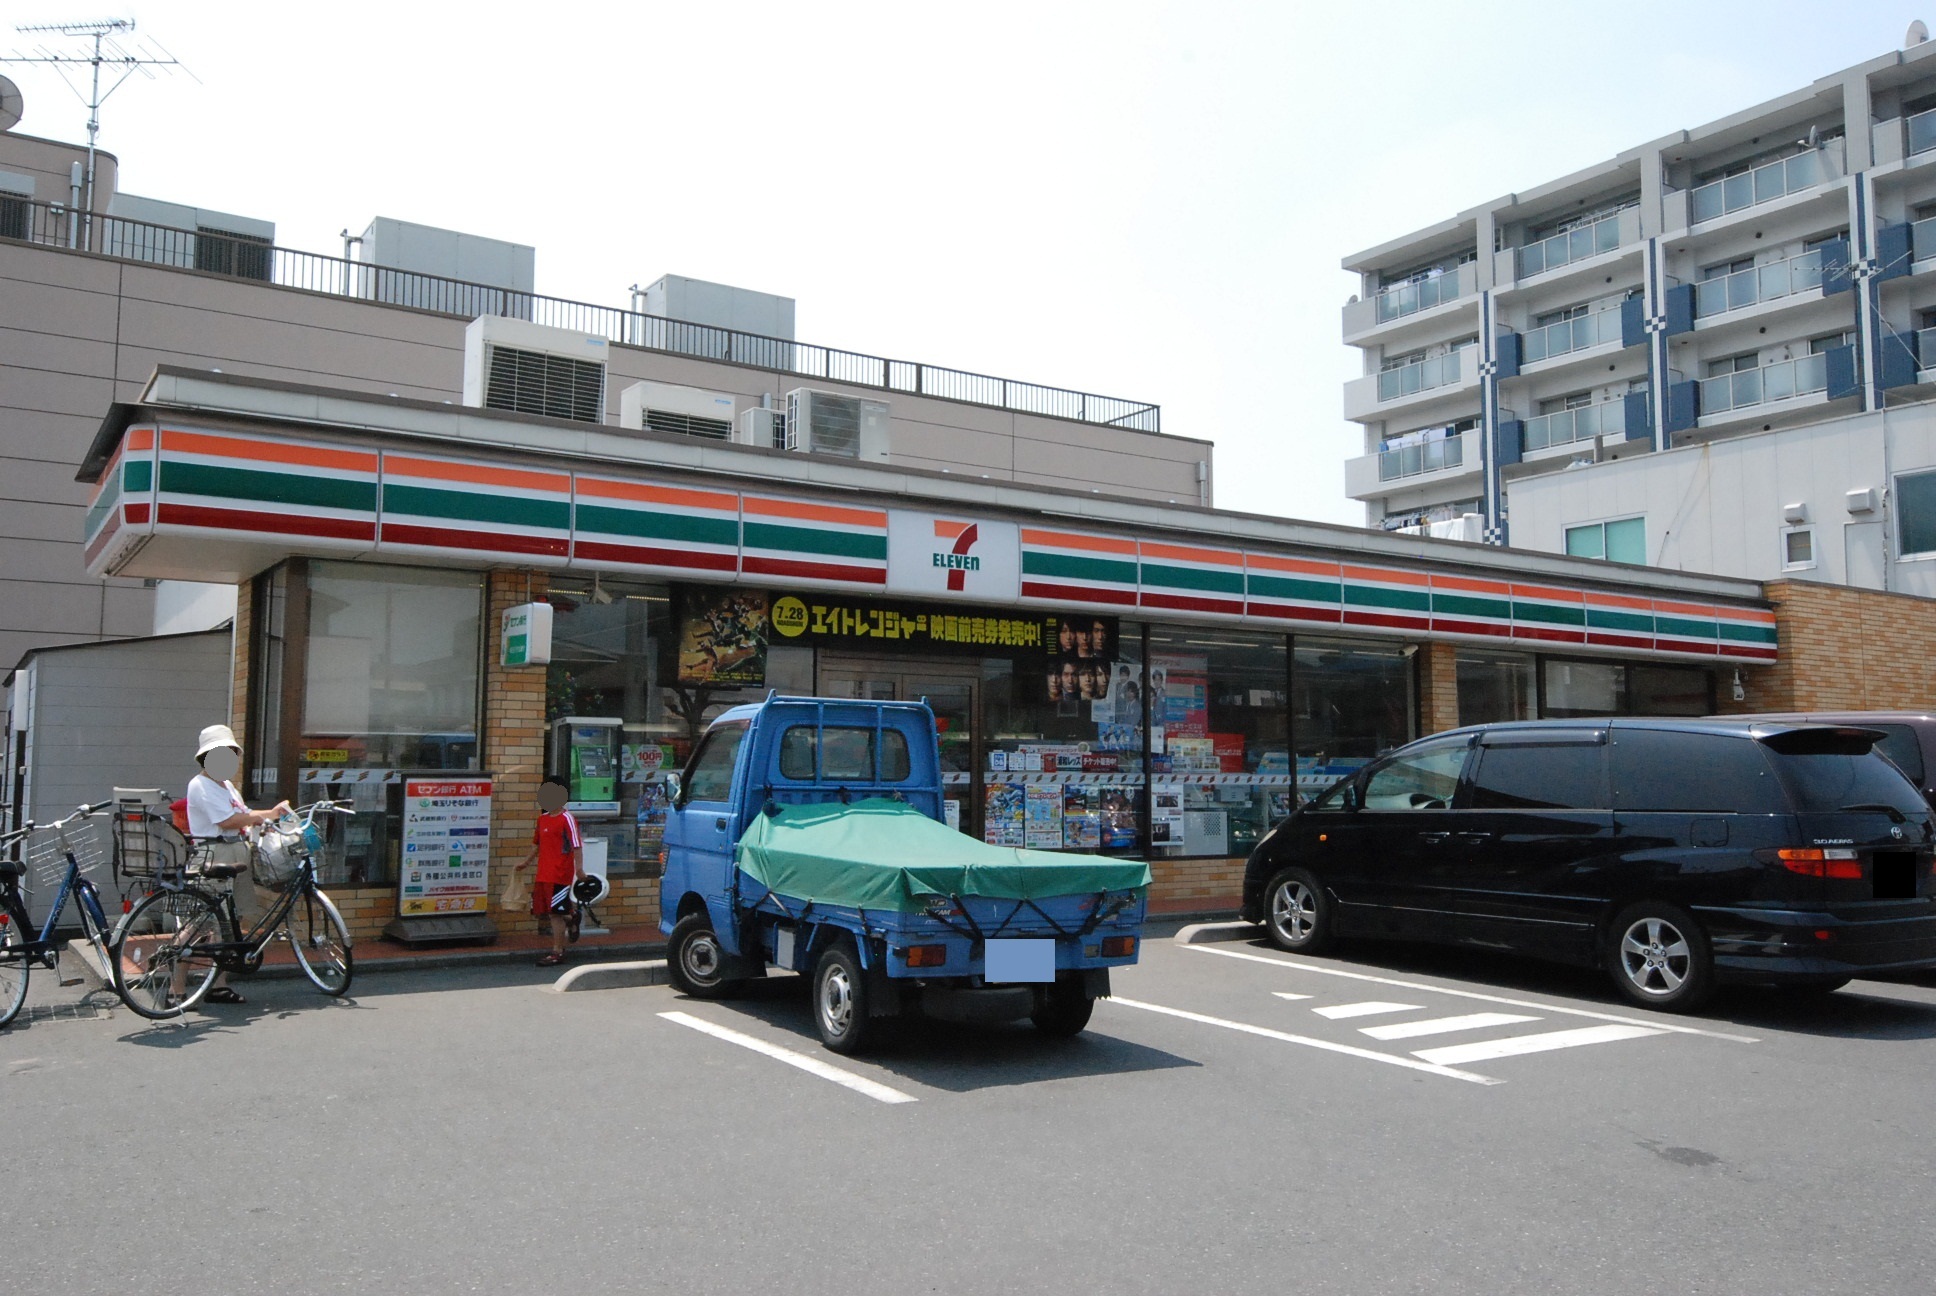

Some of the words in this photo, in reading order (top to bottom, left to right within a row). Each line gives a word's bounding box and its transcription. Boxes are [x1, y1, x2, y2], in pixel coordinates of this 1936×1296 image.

[933, 519, 978, 592] 7
[776, 605, 804, 620] 7.28
[417, 785, 457, 794] セブン銀行
[460, 785, 482, 794] ATM
[431, 799, 479, 807] 埼玉りそな銀行
